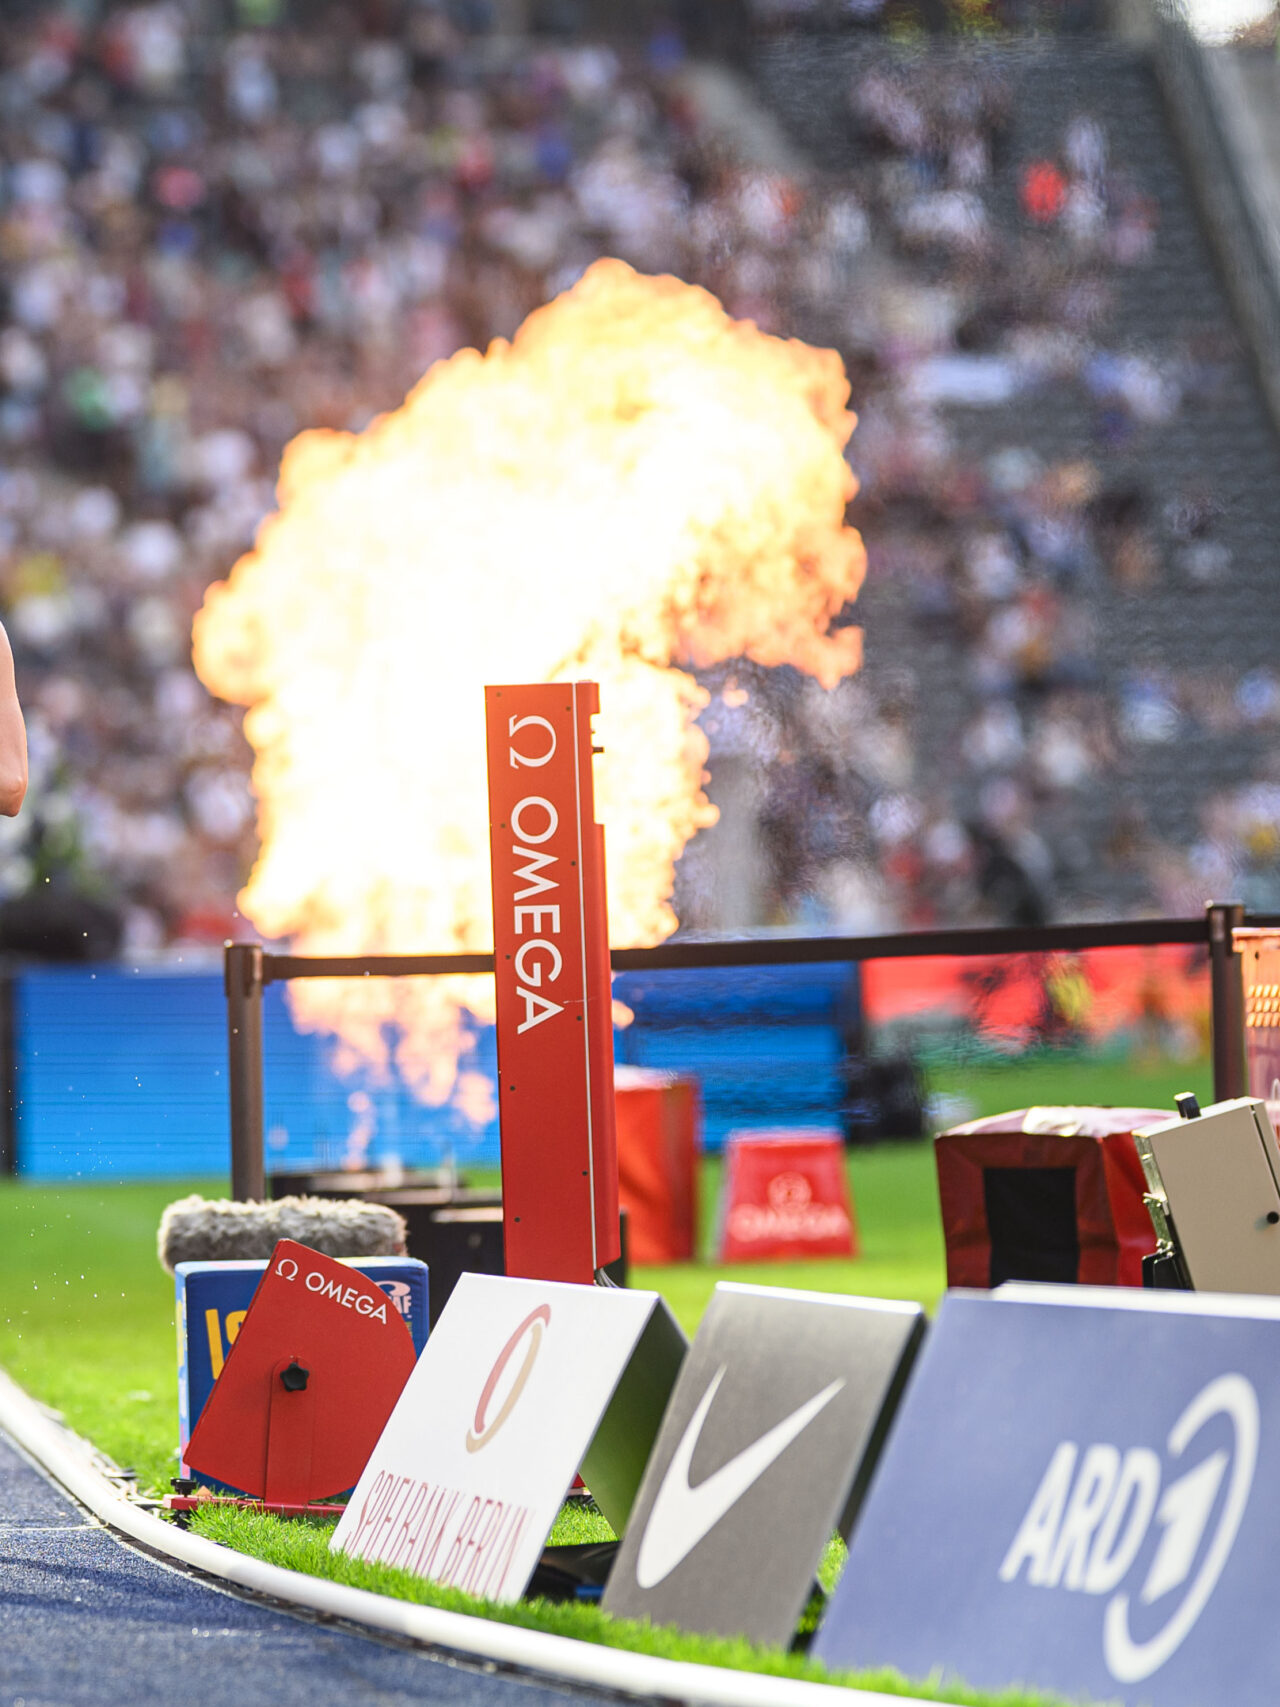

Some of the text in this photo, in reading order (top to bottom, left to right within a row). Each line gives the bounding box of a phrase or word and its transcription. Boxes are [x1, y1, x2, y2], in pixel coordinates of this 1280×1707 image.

[511, 796, 565, 1034] OMEGA
[305, 1272, 387, 1325] OMEGA
[343, 1470, 536, 1603] SPIELBANK BERLIN
[998, 1441, 1161, 1595] ARD
